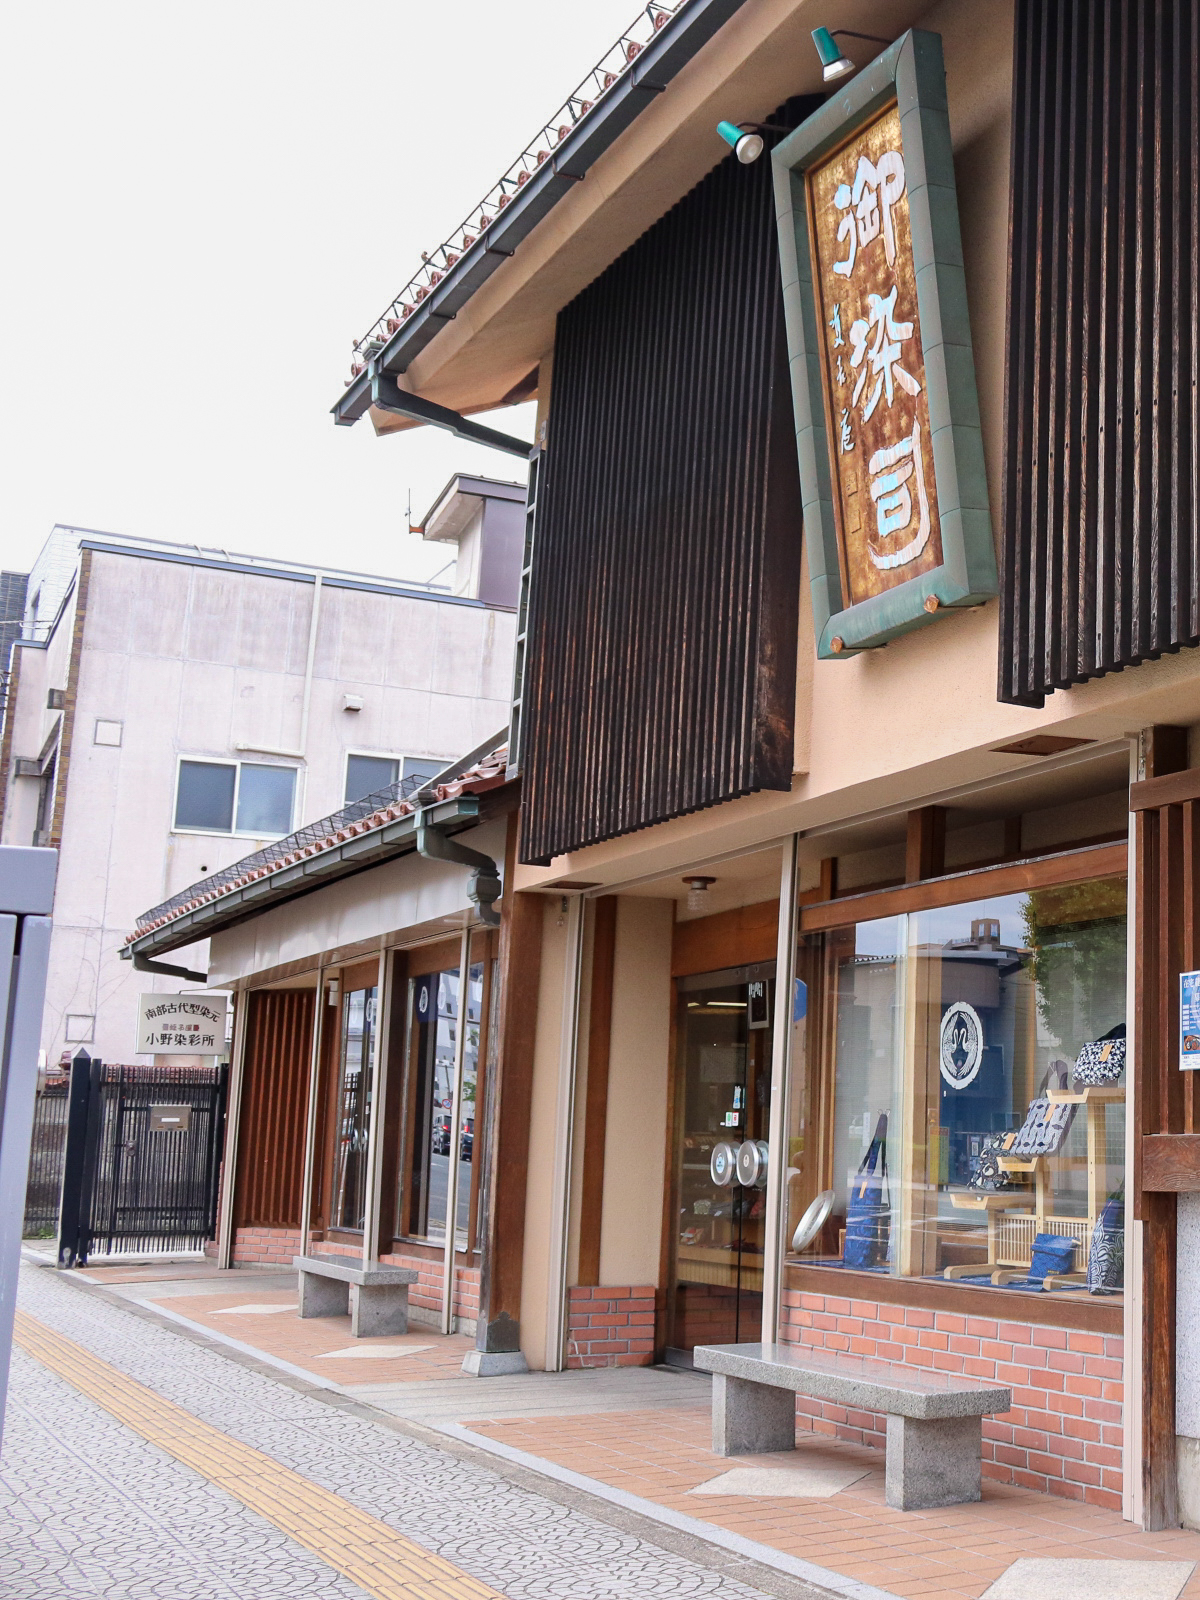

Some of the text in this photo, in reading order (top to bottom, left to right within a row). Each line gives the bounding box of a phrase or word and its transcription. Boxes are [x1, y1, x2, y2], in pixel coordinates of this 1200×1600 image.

[144, 1002, 221, 1023] 南部古代型染元
[146, 1032, 215, 1047] 小野染彩所
